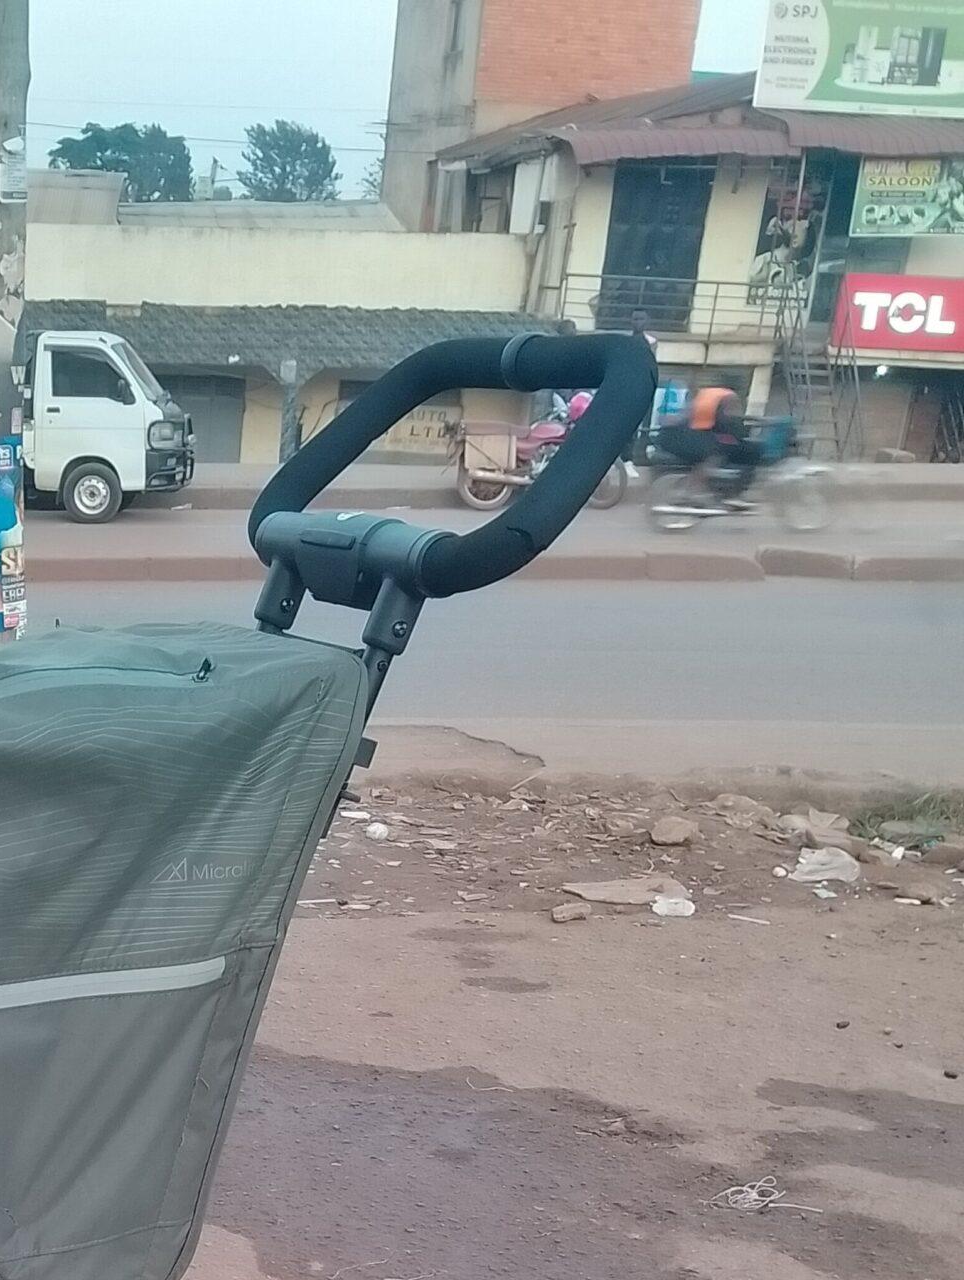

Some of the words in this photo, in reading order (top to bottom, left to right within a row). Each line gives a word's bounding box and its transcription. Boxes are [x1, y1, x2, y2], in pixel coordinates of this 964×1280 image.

[793, 5, 818, 19] SPJ
[869, 177, 932, 187] SALOON
[853, 292, 955, 335] TCL
